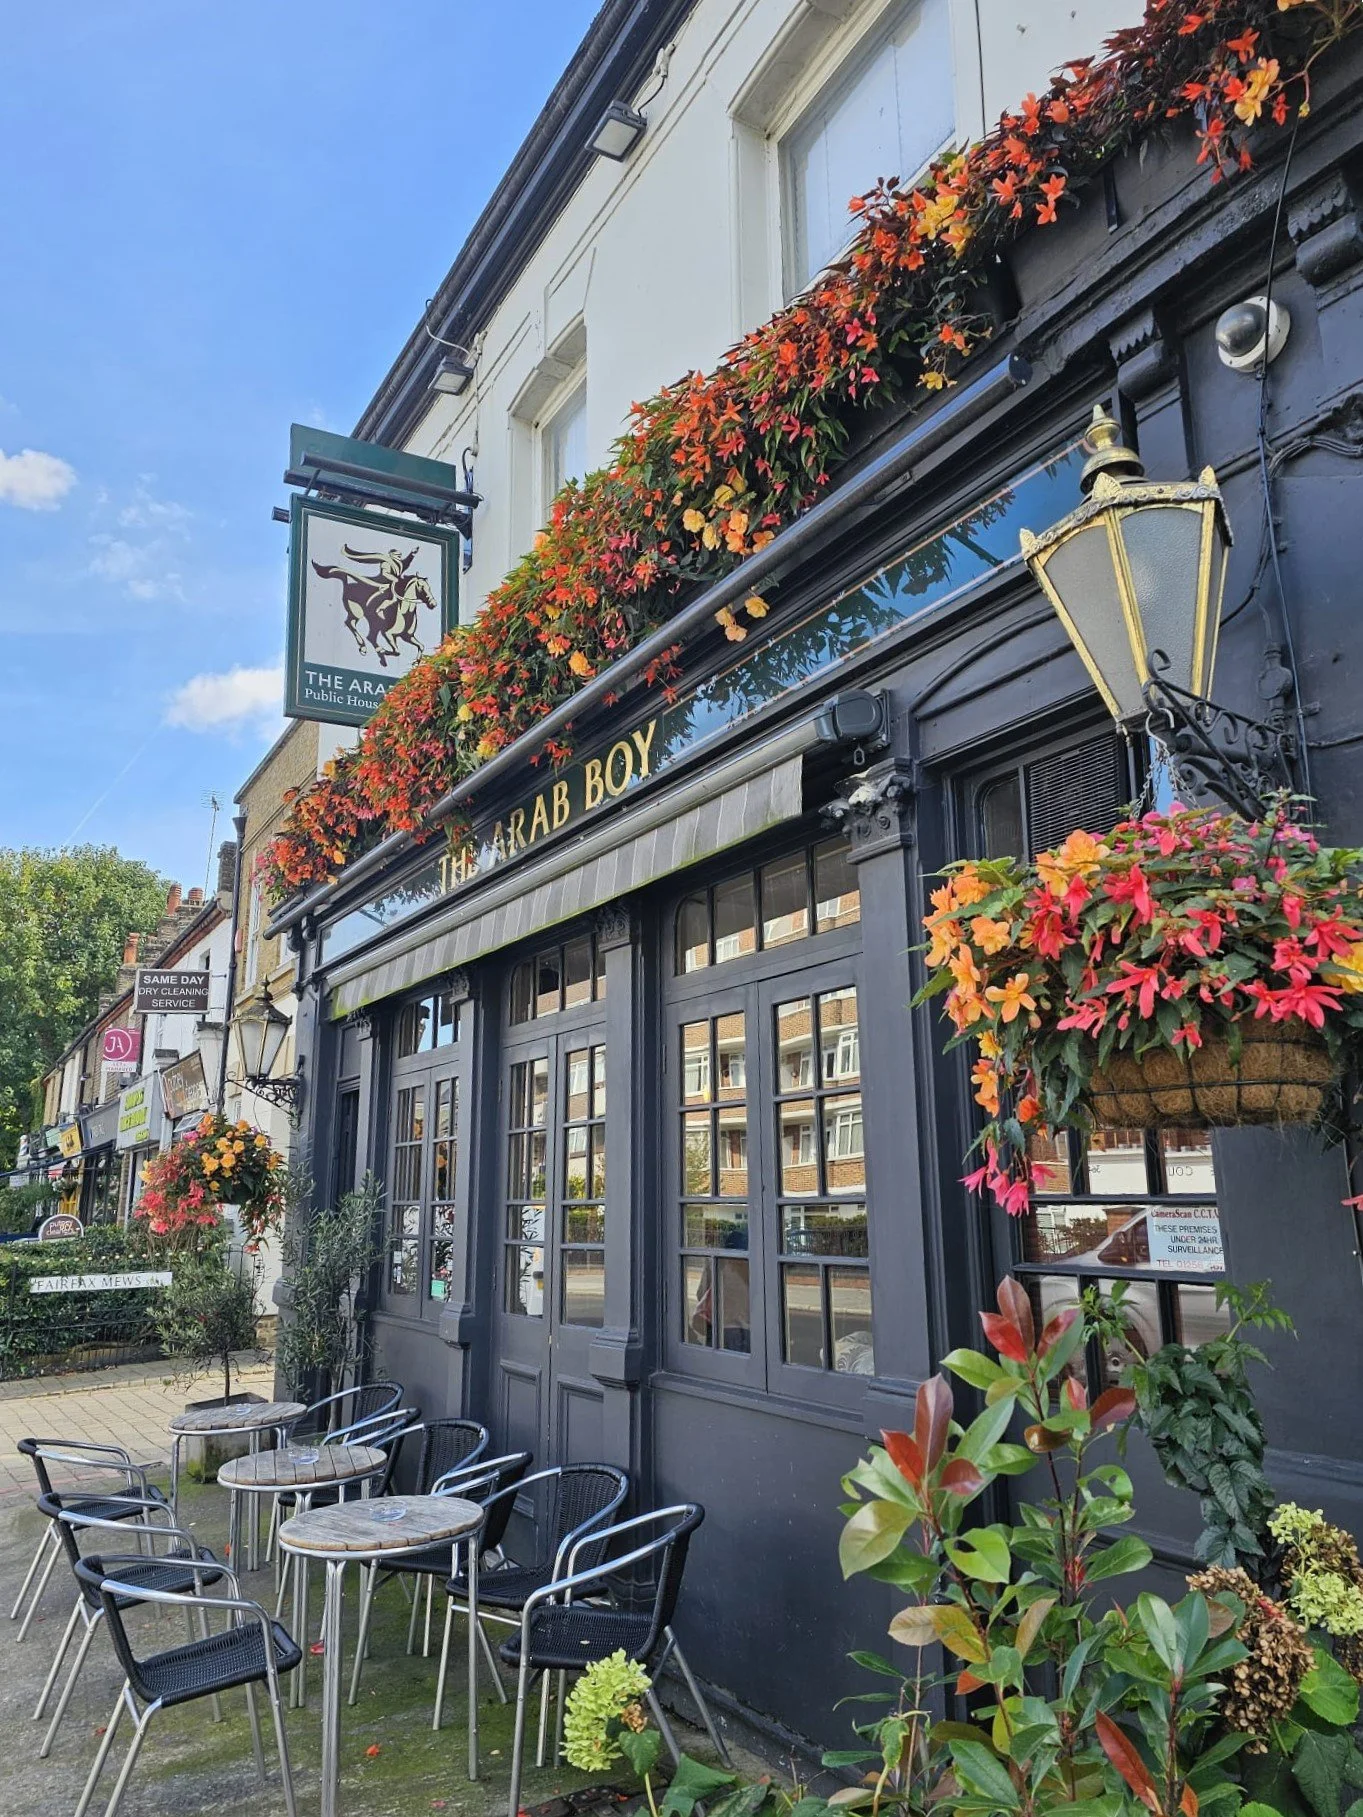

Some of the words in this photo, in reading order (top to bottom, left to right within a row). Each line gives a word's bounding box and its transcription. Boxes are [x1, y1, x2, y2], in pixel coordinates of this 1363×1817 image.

[305, 670, 343, 690] THE
[349, 679, 394, 696] ARA
[305, 688, 343, 704] Public
[347, 695, 379, 709] Hous
[489, 780, 570, 863] ARAB
[585, 719, 657, 811] BOY
[143, 975, 178, 985] SAME
[181, 976, 205, 985] DAY
[138, 987, 159, 996] DRY
[161, 987, 209, 996] CLEANING
[151, 999, 196, 1008] SERVICE
[1151, 1209, 1192, 1218] CameraScan
[1154, 1225, 1177, 1233] THESE
[1179, 1225, 1217, 1234] PREMISES
[1170, 1235, 1196, 1244] UNDER
[37, 1277, 96, 1290] FAIRFAX
[101, 1275, 141, 1288] MEWS
